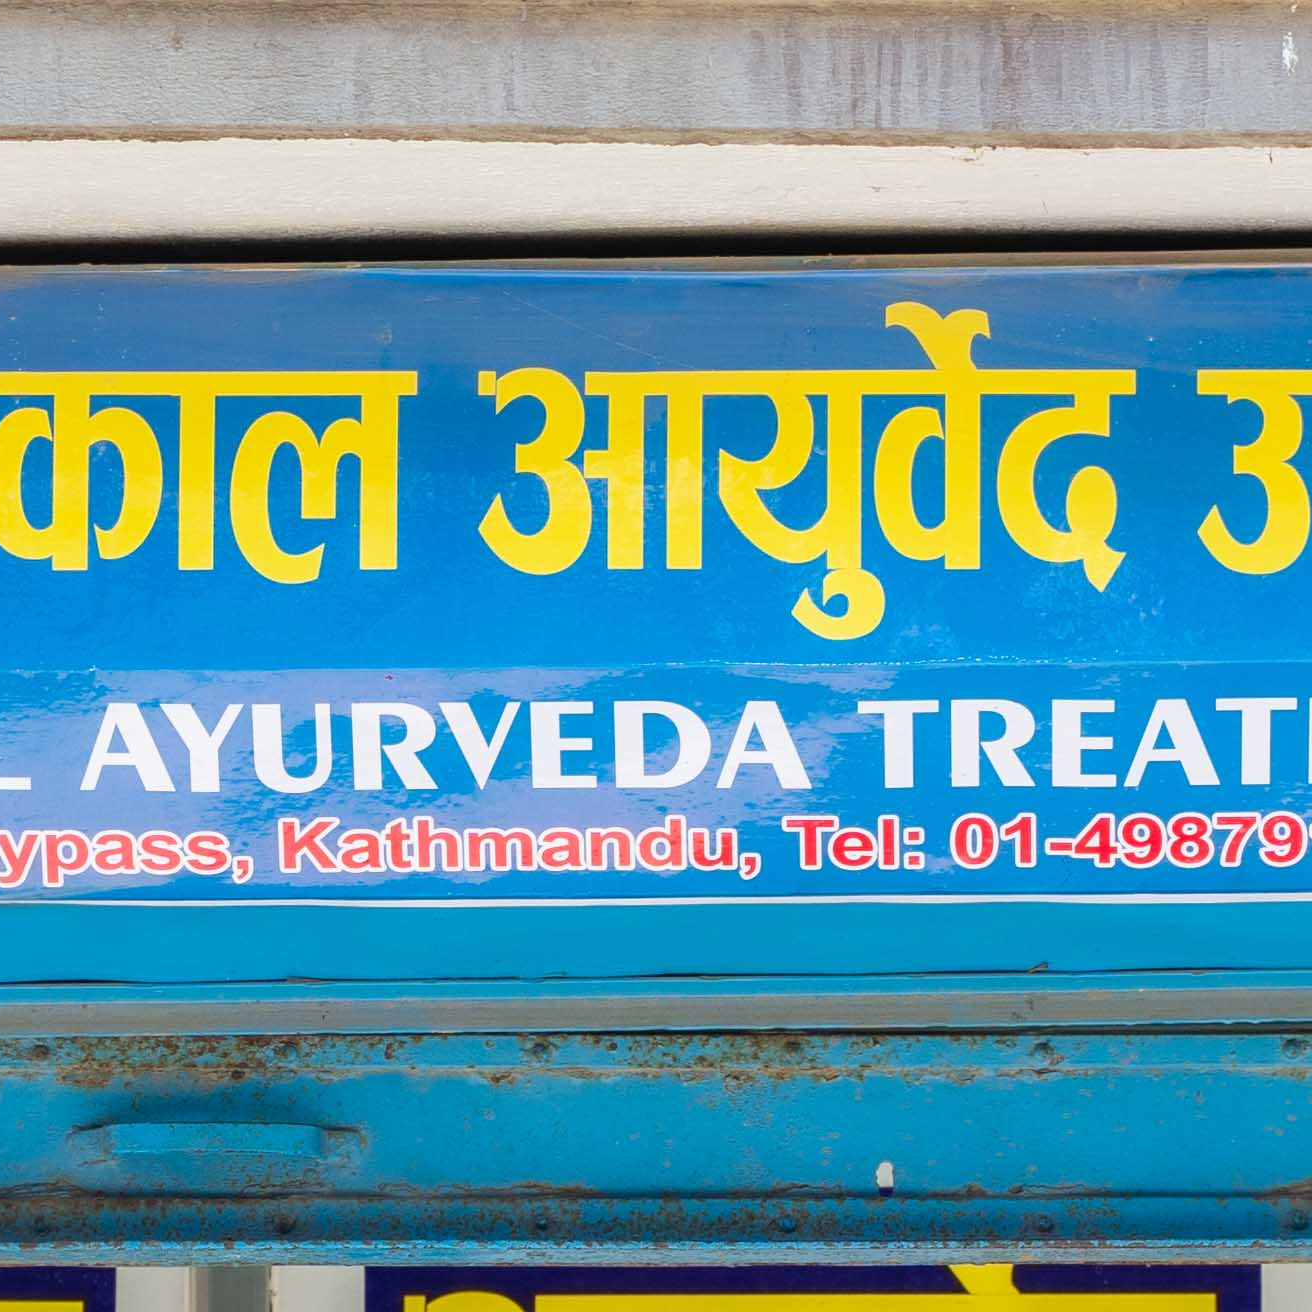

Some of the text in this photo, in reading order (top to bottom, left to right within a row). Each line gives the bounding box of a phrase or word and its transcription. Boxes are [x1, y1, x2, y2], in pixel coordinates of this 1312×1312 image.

[479, 301, 1136, 641] आयुर्वेद
[78, 700, 811, 795] AYURVEDA
[279, 811, 761, 886] Kathmandu,
[794, 813, 930, 876] Tel:
